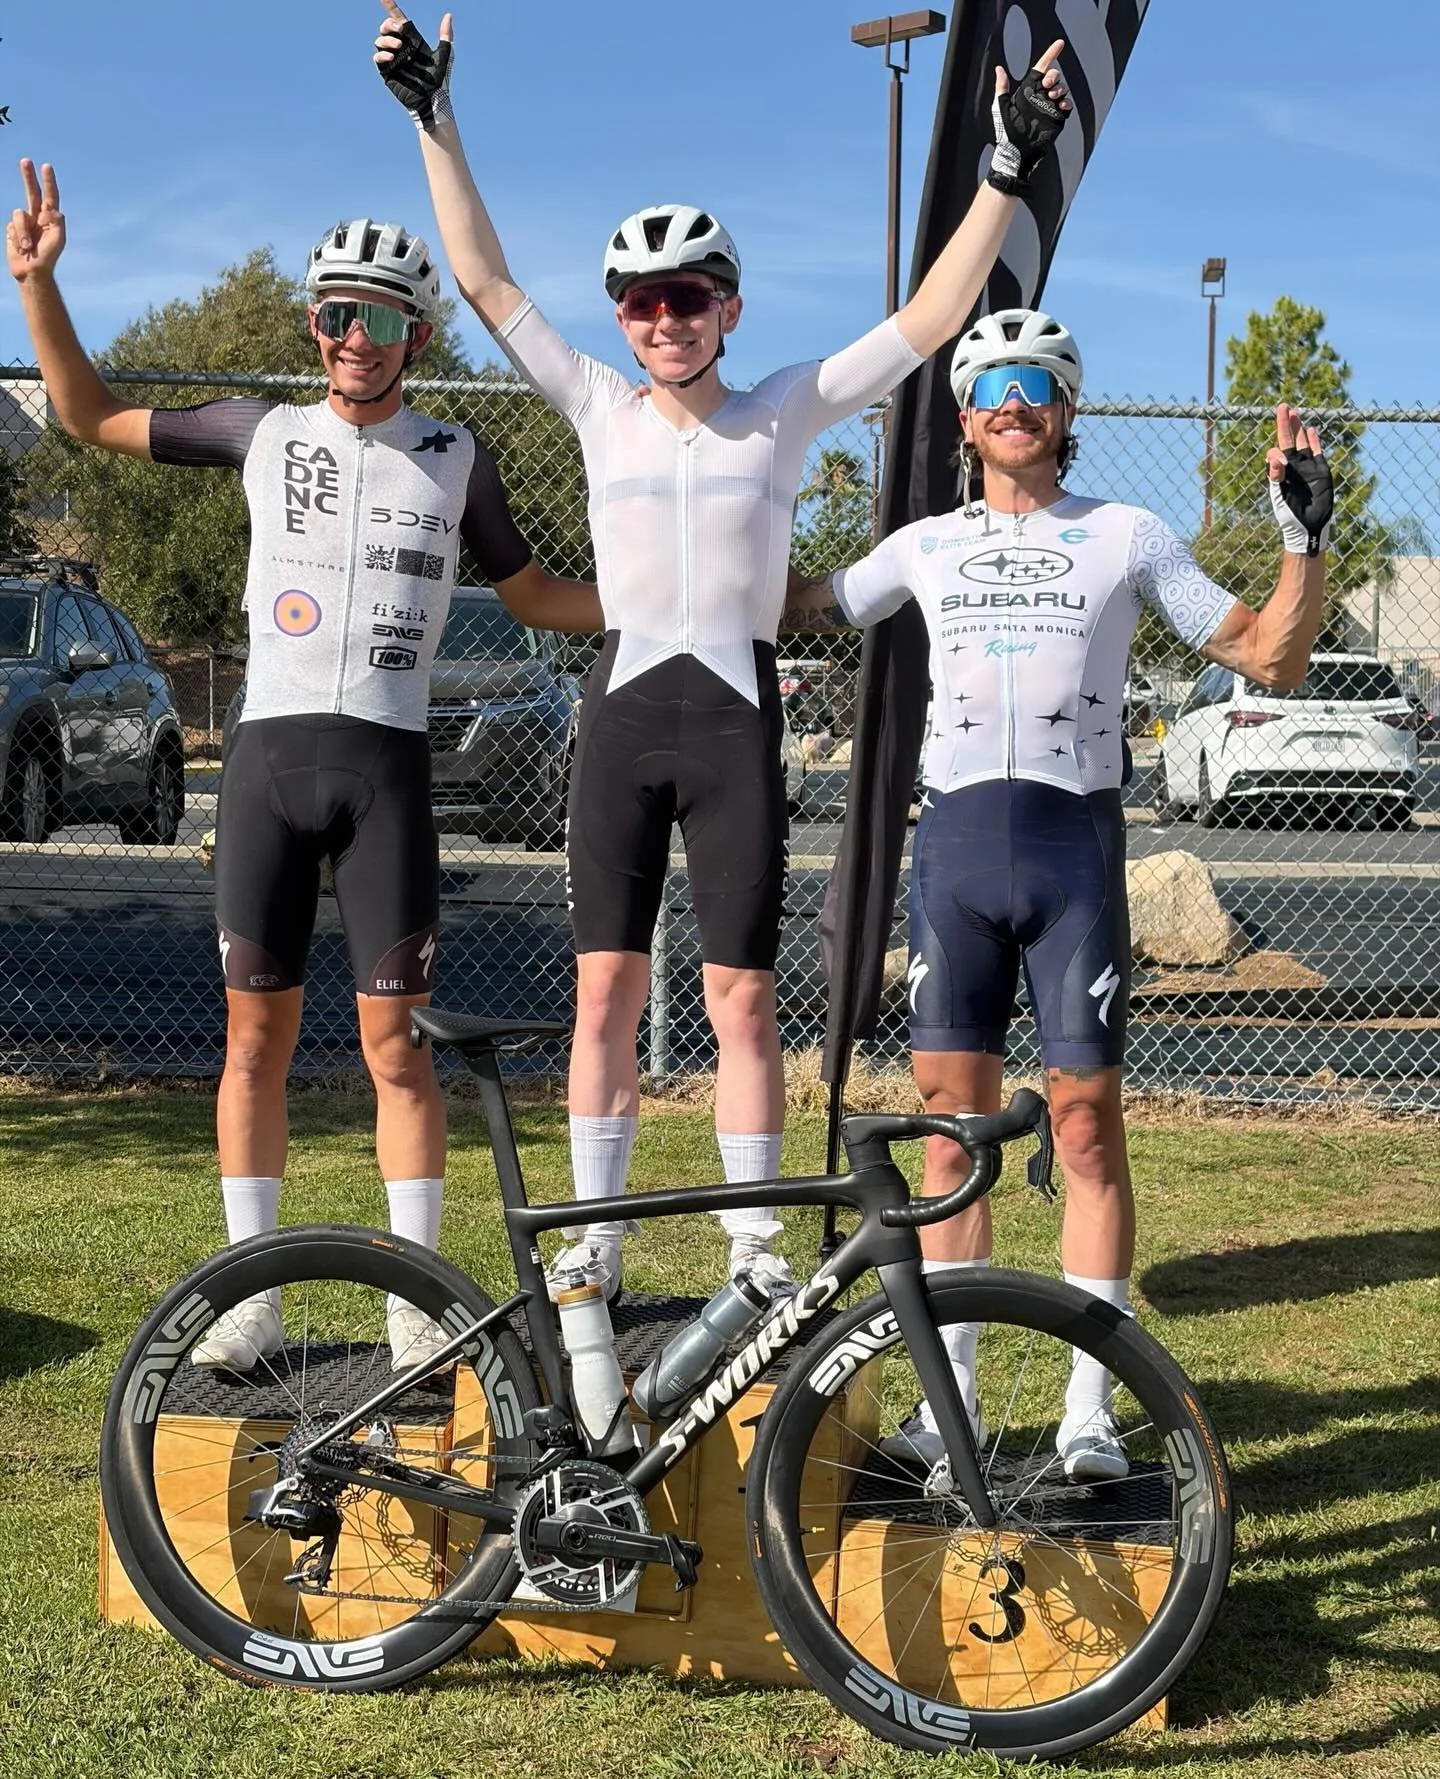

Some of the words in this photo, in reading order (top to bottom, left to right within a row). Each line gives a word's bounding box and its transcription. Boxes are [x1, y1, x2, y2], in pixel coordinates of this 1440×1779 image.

[941, 624, 987, 638] SUBARU
[1034, 624, 1086, 638] MONICA
[377, 651, 413, 666] 100%
[376, 979, 407, 990] ELIEL
[659, 1258, 840, 1468] S-WORKS
[968, 1558, 1027, 1644] 3
